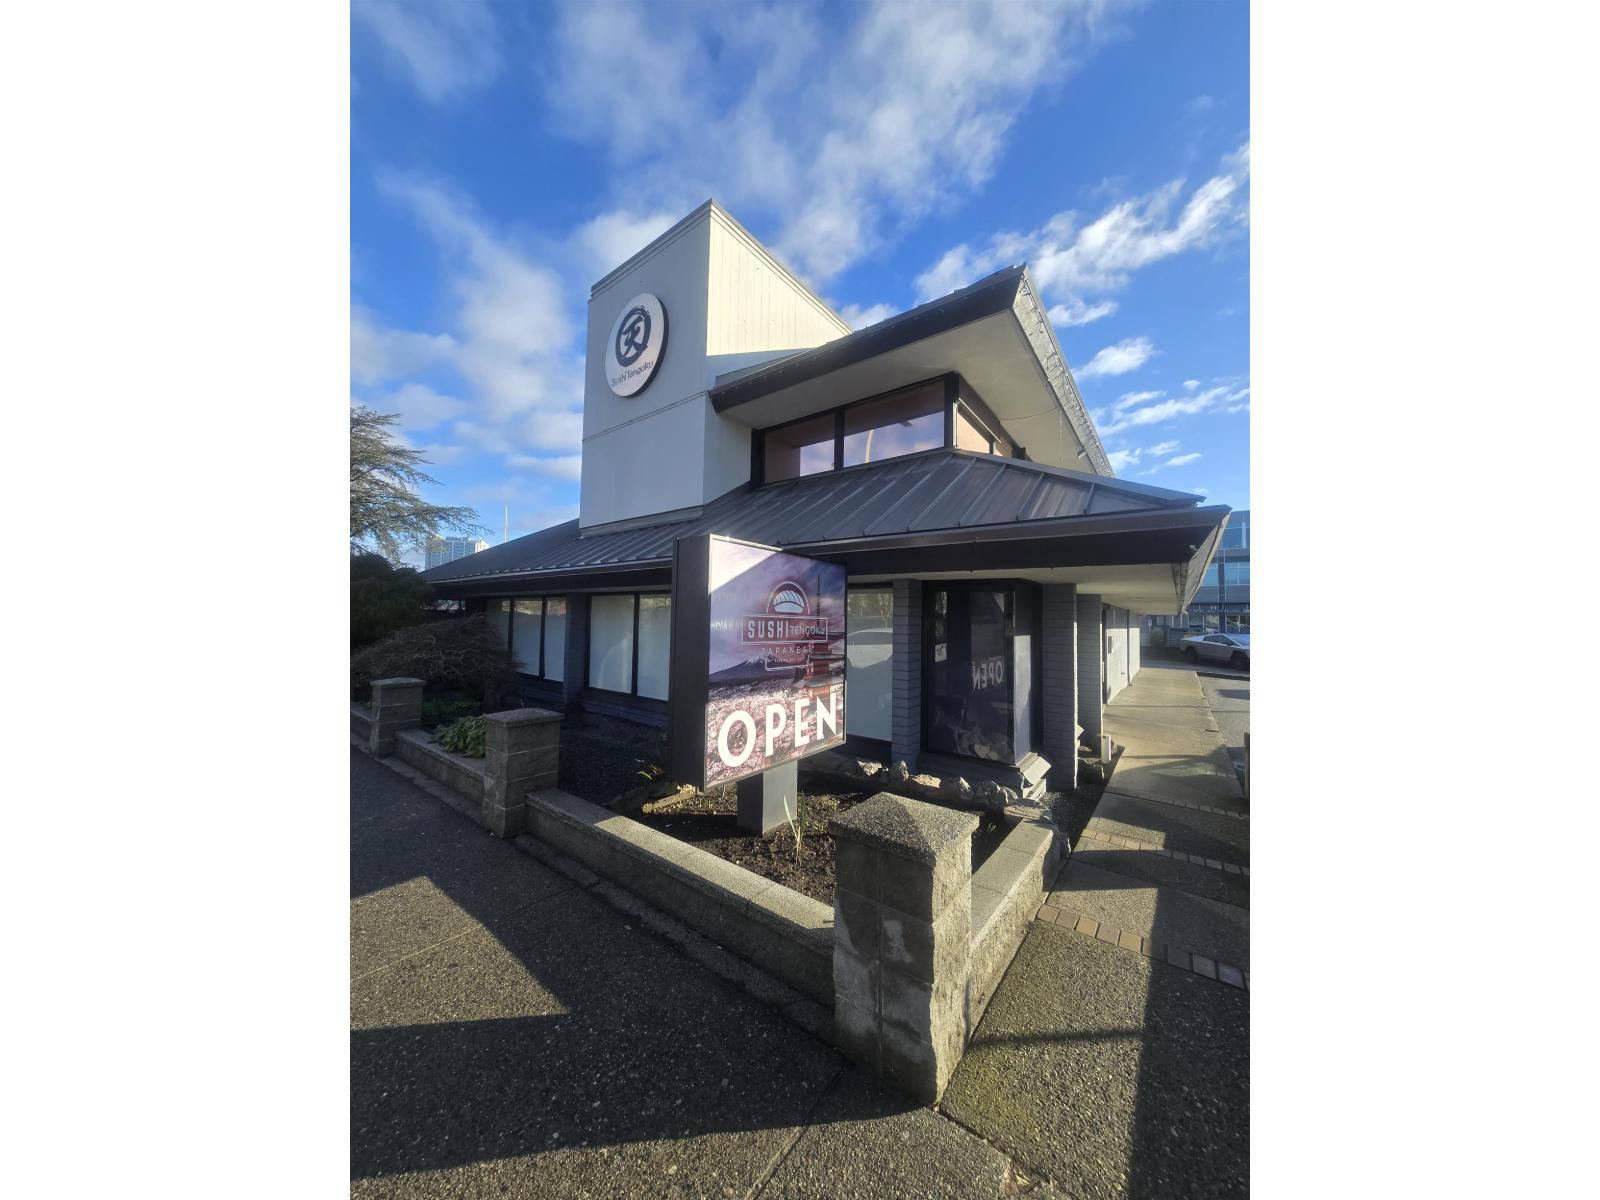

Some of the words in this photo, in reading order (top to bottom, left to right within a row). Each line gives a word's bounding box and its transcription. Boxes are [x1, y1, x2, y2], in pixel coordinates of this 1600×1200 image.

[611, 370, 626, 388] Sushi
[627, 361, 654, 380] Tengoku
[747, 619, 789, 639] SUSHI
[760, 644, 814, 655] JAPANESE
[717, 693, 837, 768] OPEN
